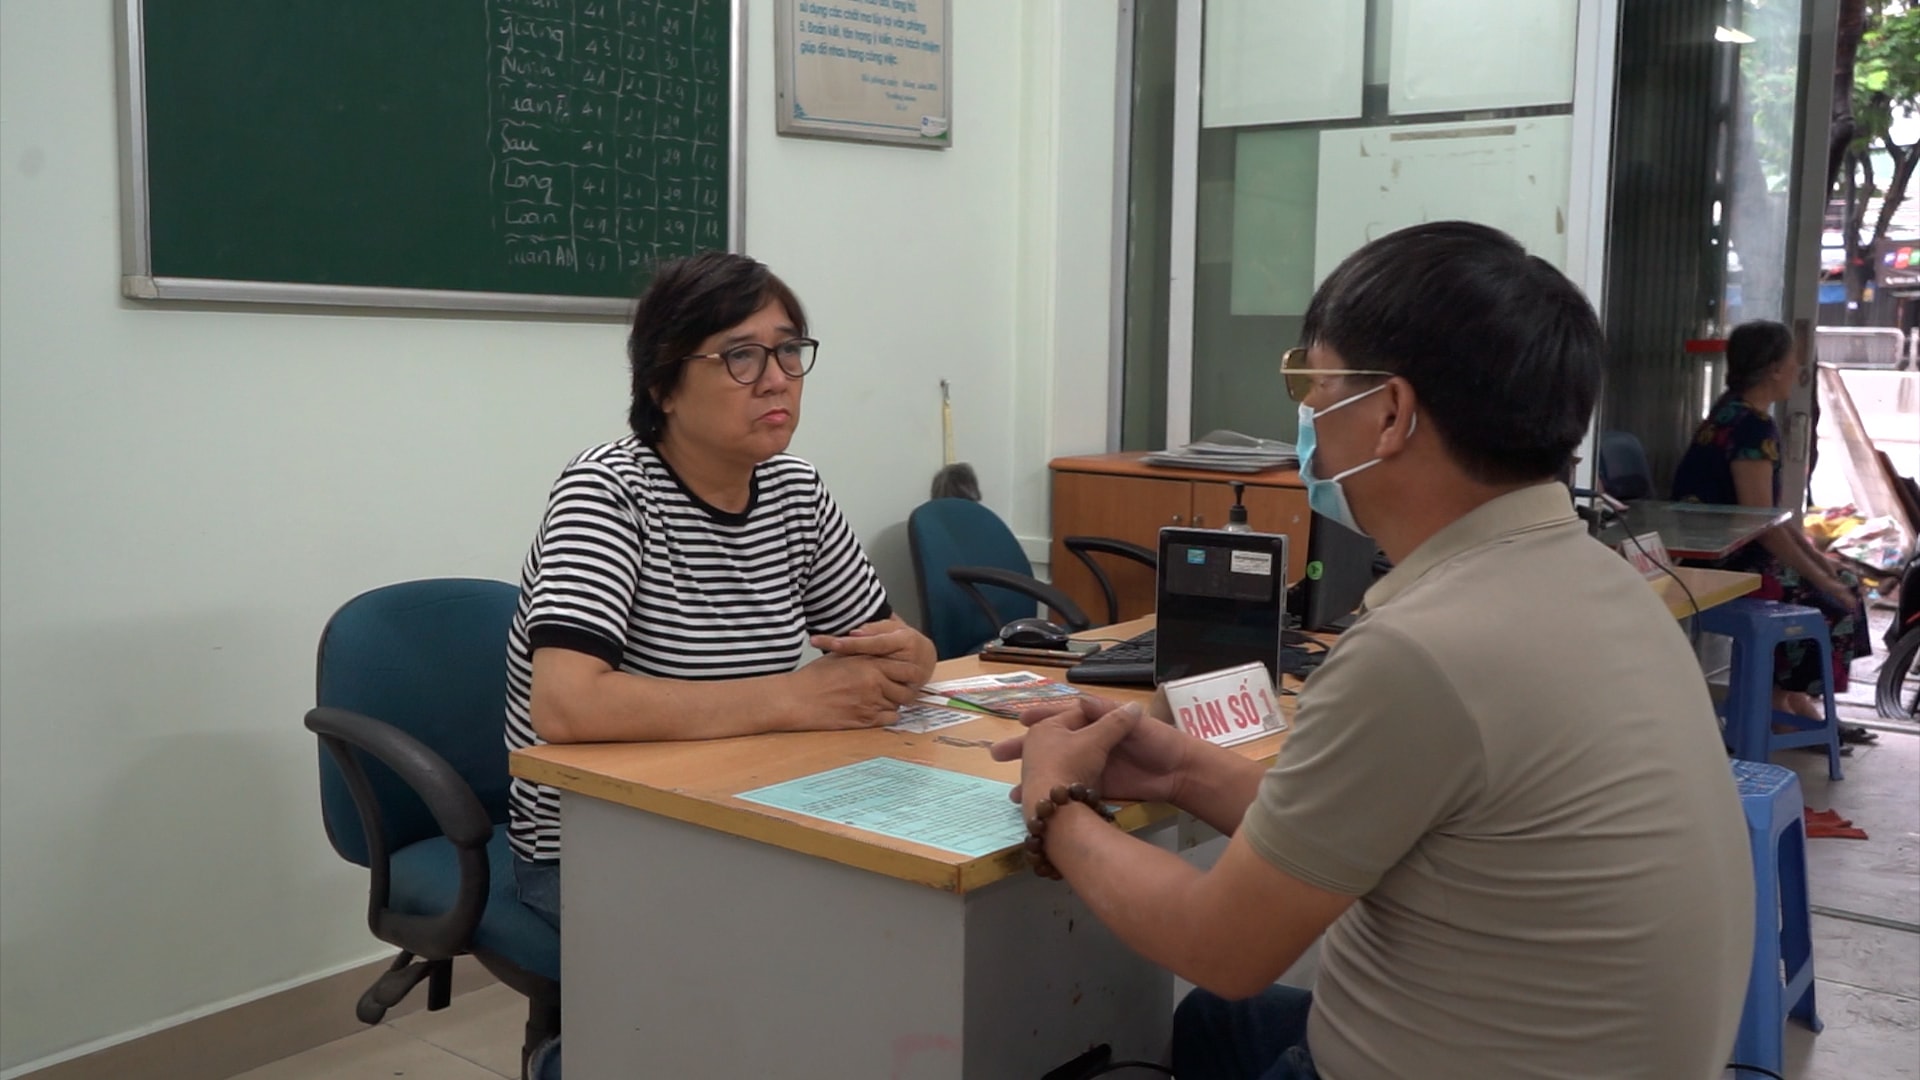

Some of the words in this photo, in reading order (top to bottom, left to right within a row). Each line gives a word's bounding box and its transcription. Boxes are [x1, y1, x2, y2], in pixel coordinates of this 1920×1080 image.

[1178, 695, 1231, 739] BÀN
[1227, 677, 1261, 730] SỐ
[1258, 687, 1274, 715] 1
